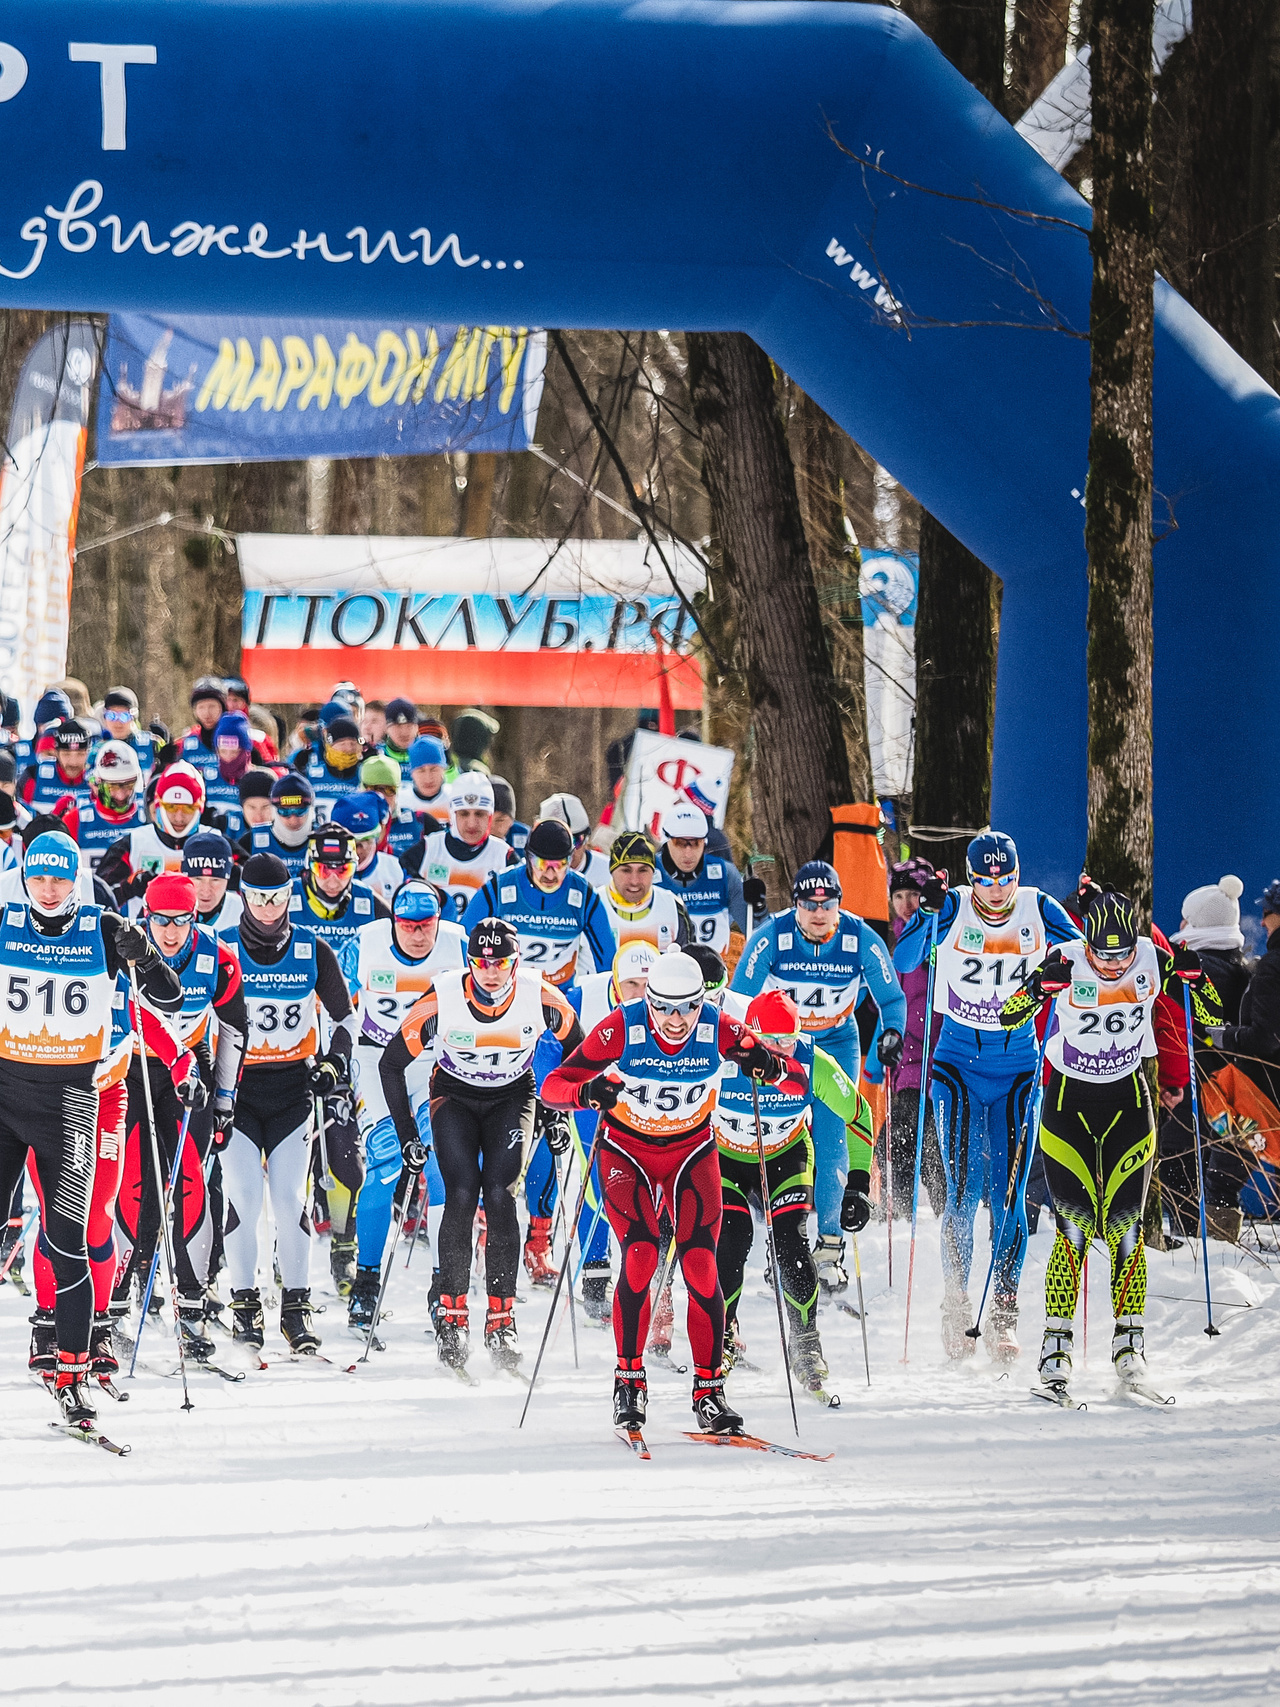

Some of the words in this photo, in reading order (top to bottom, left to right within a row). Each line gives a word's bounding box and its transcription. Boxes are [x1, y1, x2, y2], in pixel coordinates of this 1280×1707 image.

[196, 327, 439, 413] МАРАФОН
[433, 325, 529, 414] МГУ
[26, 853, 70, 870] LUKOIL
[187, 857, 219, 868] VITAL
[983, 847, 1008, 868] DNB
[799, 877, 831, 891] VITAL
[677, 891, 721, 901] АВТОБАНК
[509, 914, 579, 927] РОСАВТОБАНК
[477, 930, 502, 948] DNB
[16, 942, 93, 955] РОСАВТОБАНК
[519, 942, 571, 963] 27
[788, 962, 854, 974] РОСАВТОБАНК
[960, 957, 1031, 986] 214
[6, 973, 90, 1017] 516
[960, 1001, 1002, 1018] МАРА
[1078, 1004, 1146, 1037] 263
[18, 1042, 66, 1054] МАРАФОН
[67, 1044, 86, 1053] МГУ
[456, 1050, 529, 1067] 217
[638, 1057, 710, 1068] РОСАВТОБАНК
[1077, 1047, 1140, 1068] МАРАФОН
[1070, 1062, 1084, 1073] МГУ
[72, 1131, 87, 1174] SWIX
[615, 1370, 646, 1379] ROSSIGNO
